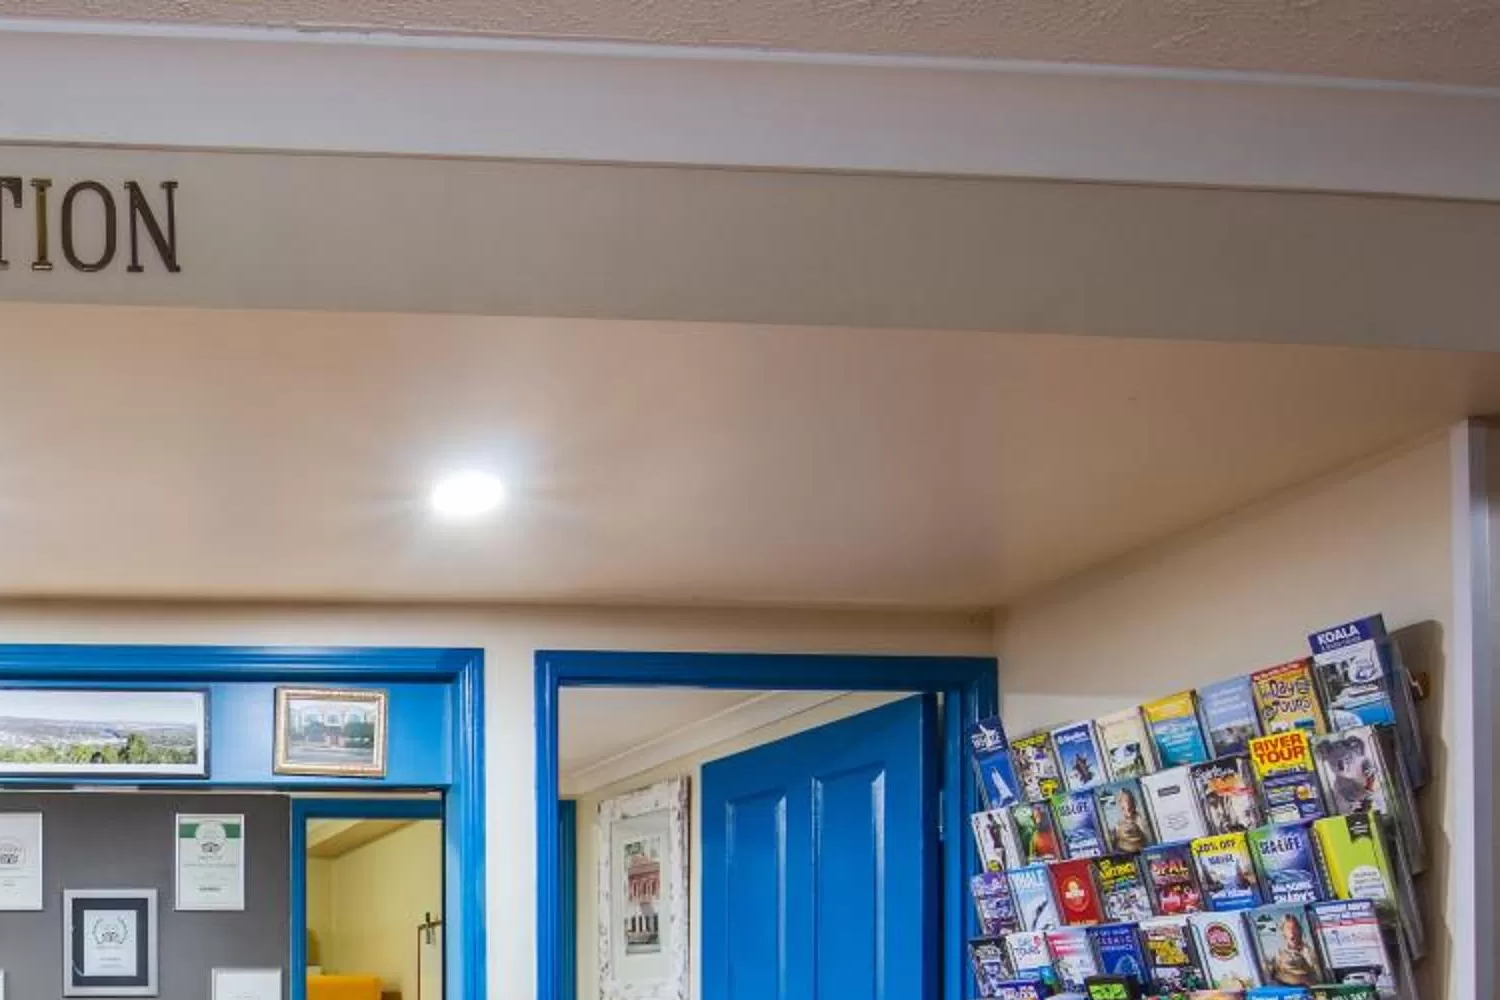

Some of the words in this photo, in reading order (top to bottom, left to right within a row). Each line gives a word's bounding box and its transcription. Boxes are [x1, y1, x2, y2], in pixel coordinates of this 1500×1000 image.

[1316, 624, 1361, 646] KOALA
[1252, 733, 1302, 753] RIVER
[1256, 745, 1305, 765] TOUR
